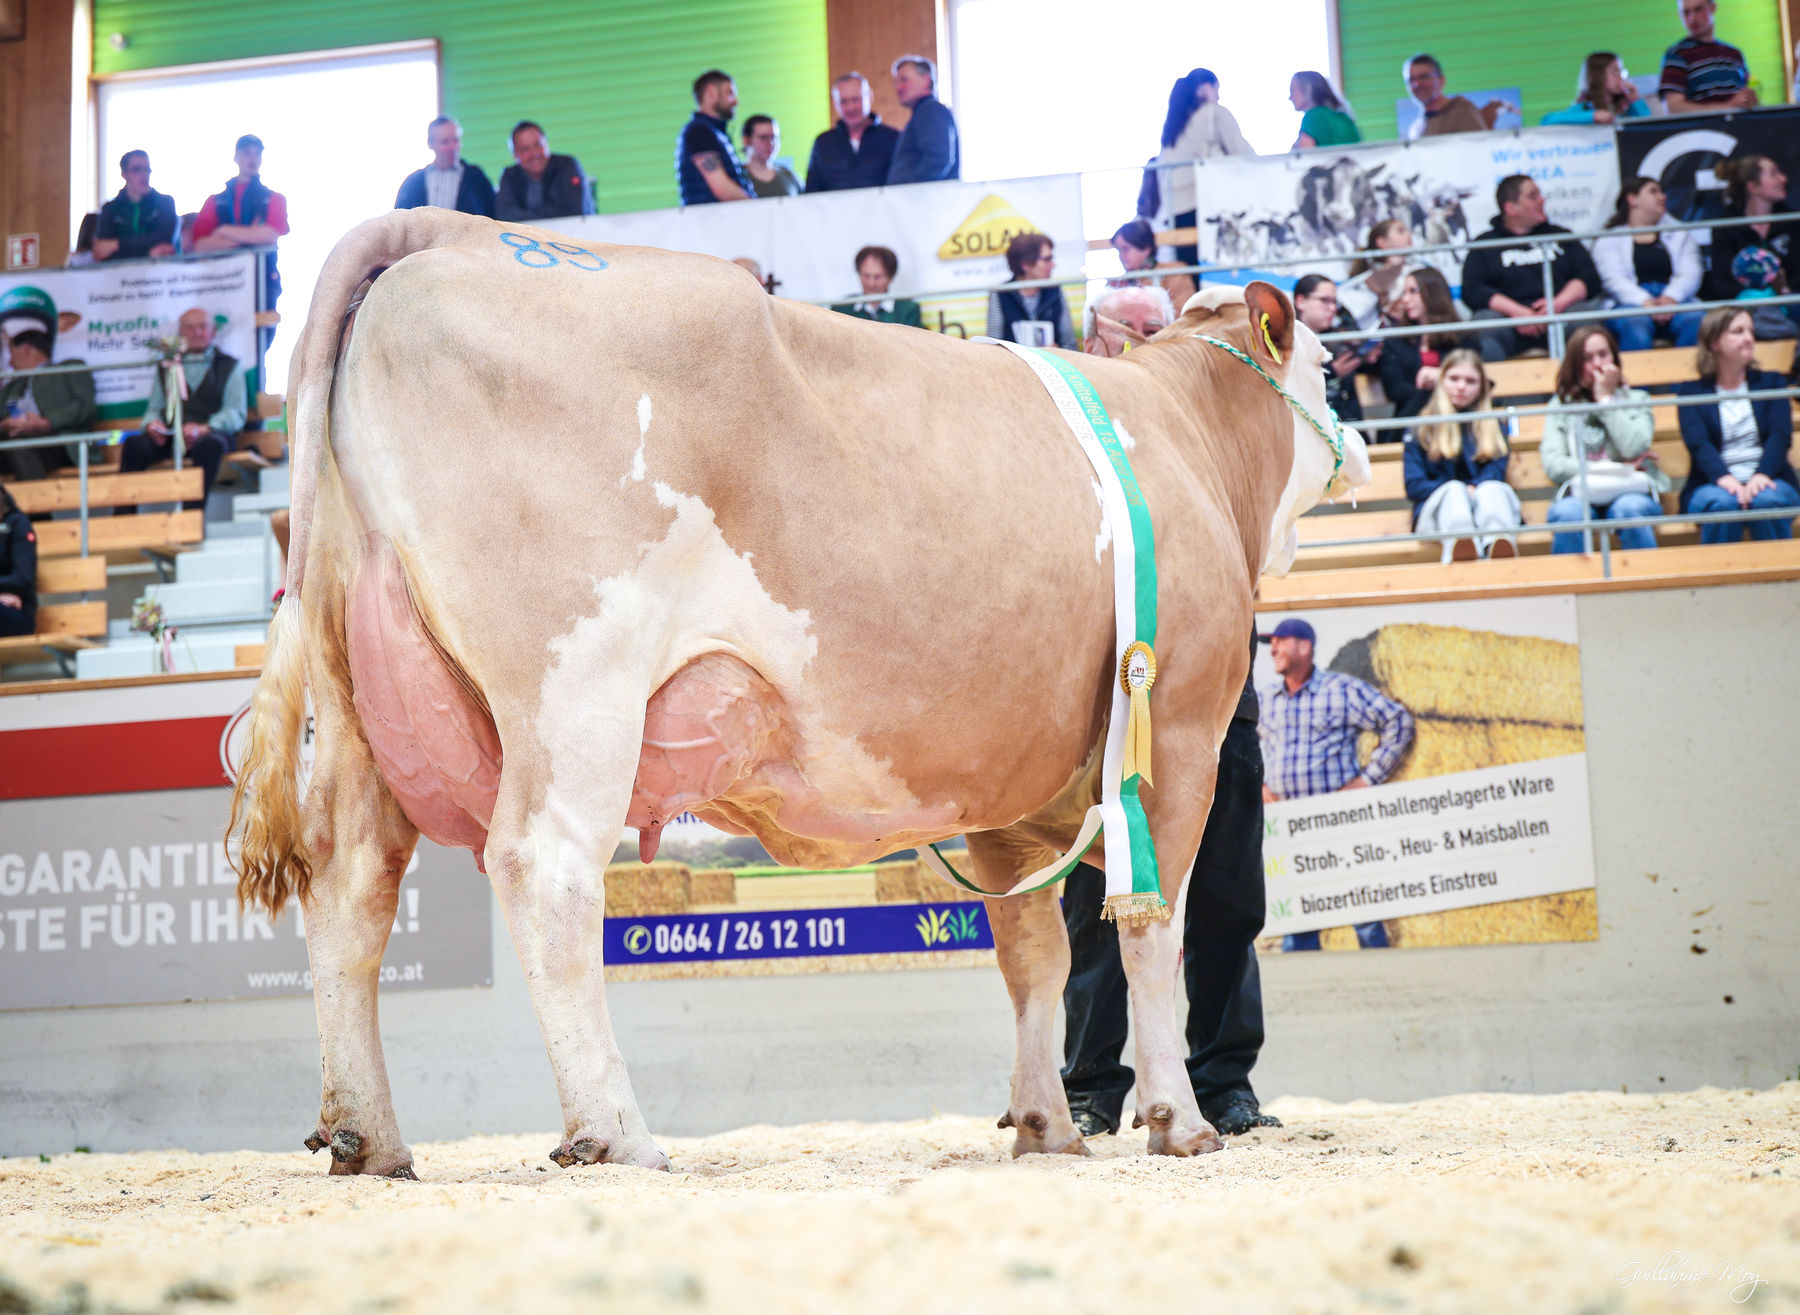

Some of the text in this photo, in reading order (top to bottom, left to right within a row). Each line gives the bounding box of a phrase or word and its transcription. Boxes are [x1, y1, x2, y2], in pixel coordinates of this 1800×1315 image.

[1491, 142, 1613, 163] Wir vertrauen
[1545, 186, 1592, 199] elken
[499, 232, 609, 272] 89
[88, 316, 158, 337] Mycofix
[1107, 447, 1131, 477] April
[1288, 777, 1555, 838] permanent hallengelagerte Ware
[1294, 820, 1550, 874] Stroh-, Silo-, Heu- & Maisballen
[0, 840, 240, 897] GARANTIE
[1301, 870, 1498, 915] biozertifiziertes Einstreu
[80, 890, 177, 950] FÜR
[190, 897, 275, 944] IHR
[655, 917, 845, 954] 0664 / 26 12 101
